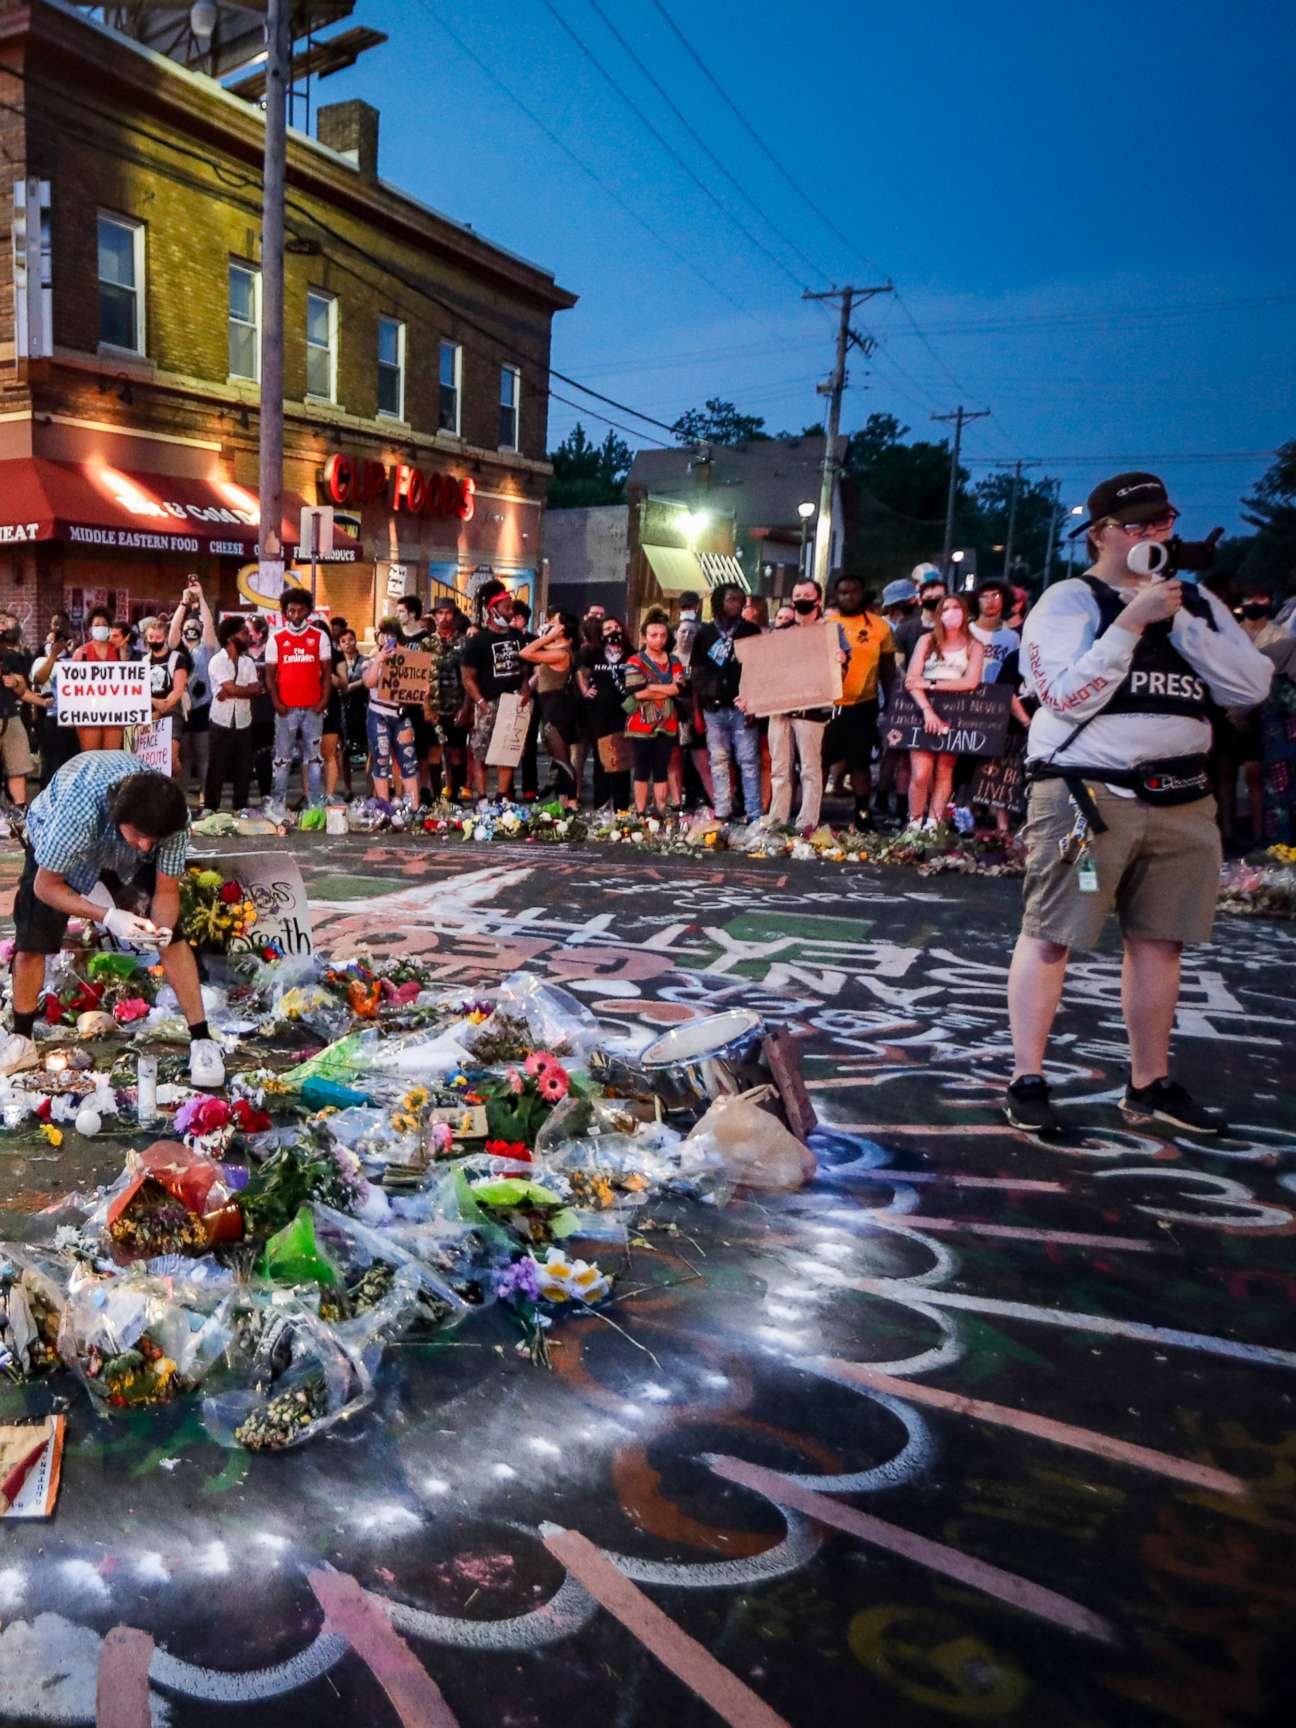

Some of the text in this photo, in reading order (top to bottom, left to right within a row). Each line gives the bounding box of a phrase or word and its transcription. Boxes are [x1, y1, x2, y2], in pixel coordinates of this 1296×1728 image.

[323, 453, 477, 522] CUP FOODS
[69, 526, 117, 545] MIDDLE
[117, 531, 169, 550] EASTERN
[170, 537, 199, 552] FOOD
[209, 540, 245, 555] CHEESE
[386, 653, 404, 666] NO
[62, 666, 146, 680] YOU PUT THE
[390, 664, 427, 680] JUSTICE
[382, 675, 401, 689] NO
[1130, 671, 1204, 700] PRESS
[62, 684, 143, 696] CHAUVIN
[390, 688, 427, 702] PEACE
[59, 709, 149, 723] CHAUVINIST
[907, 727, 922, 748] I
[672, 892, 960, 910] GEORGE
